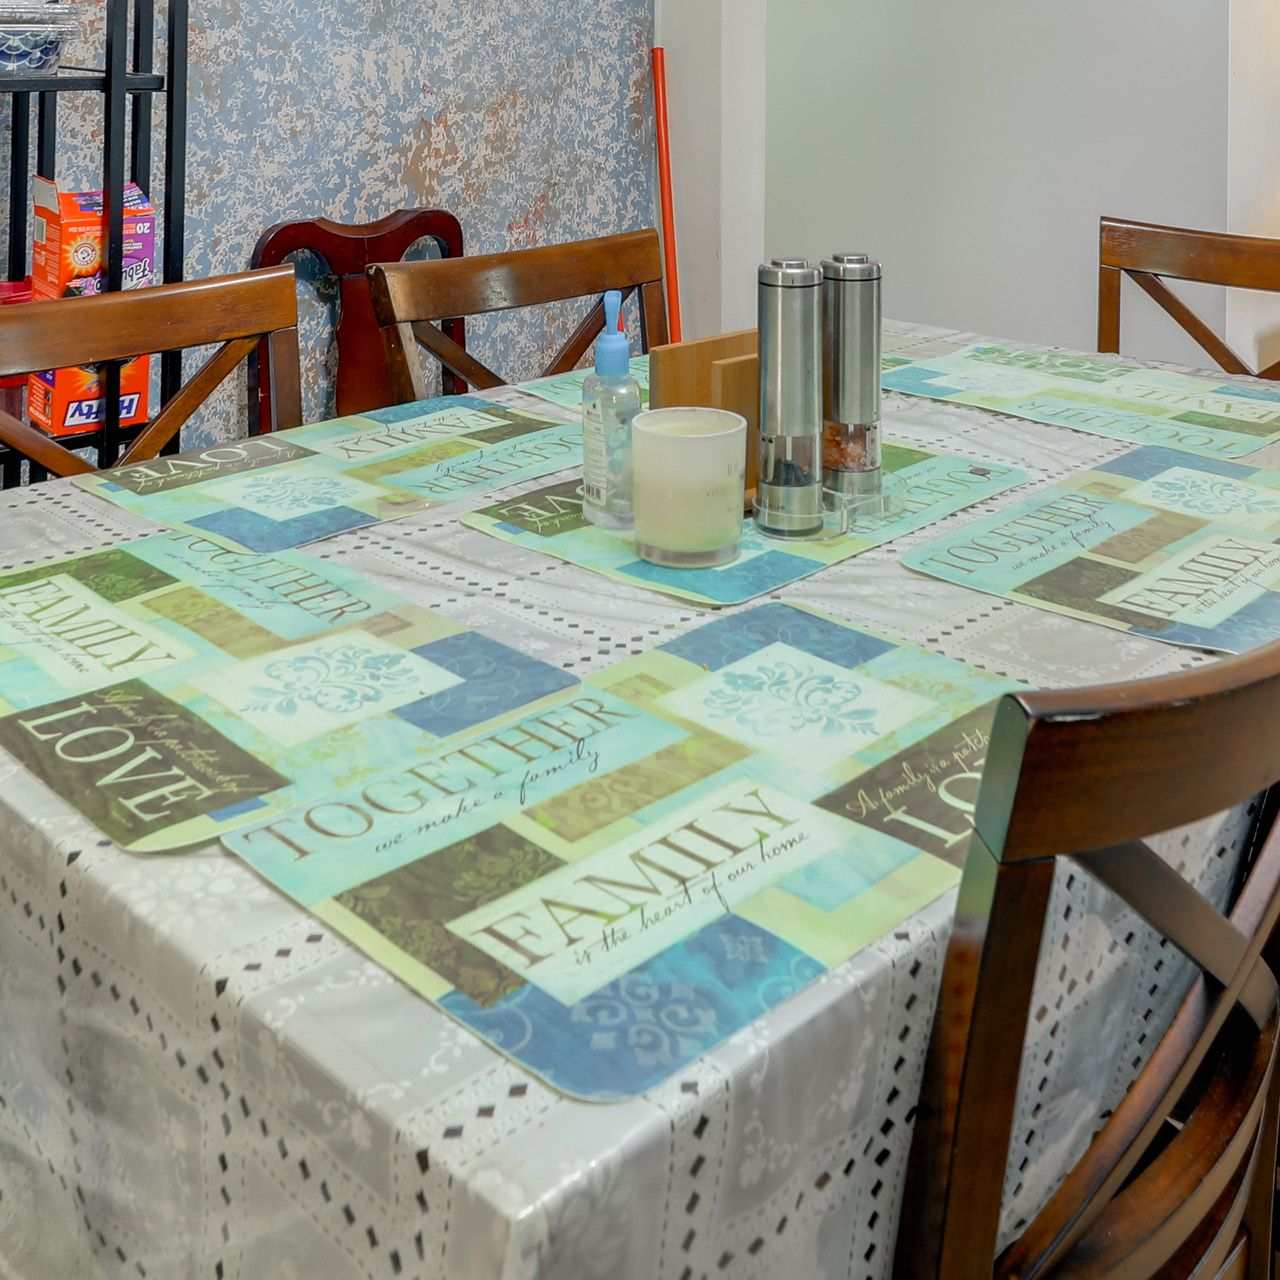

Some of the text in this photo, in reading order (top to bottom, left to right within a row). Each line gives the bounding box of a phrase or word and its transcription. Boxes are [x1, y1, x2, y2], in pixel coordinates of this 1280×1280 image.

[136, 222, 151, 235] 20
[113, 439, 288, 481] LOVE
[337, 412, 499, 459] FAMILY
[404, 433, 583, 495] OGETHER
[920, 494, 1114, 575] TOGETHER
[1117, 537, 1272, 618] FAMILY
[18, 701, 213, 822] LOVE
[242, 697, 642, 861] TOGETHER
[374, 736, 602, 854] we make a family
[846, 788, 879, 818] A
[878, 761, 937, 817] family
[883, 758, 985, 849] LO
[471, 788, 800, 970] FAMILY
[573, 831, 812, 967] is the heart of our home
